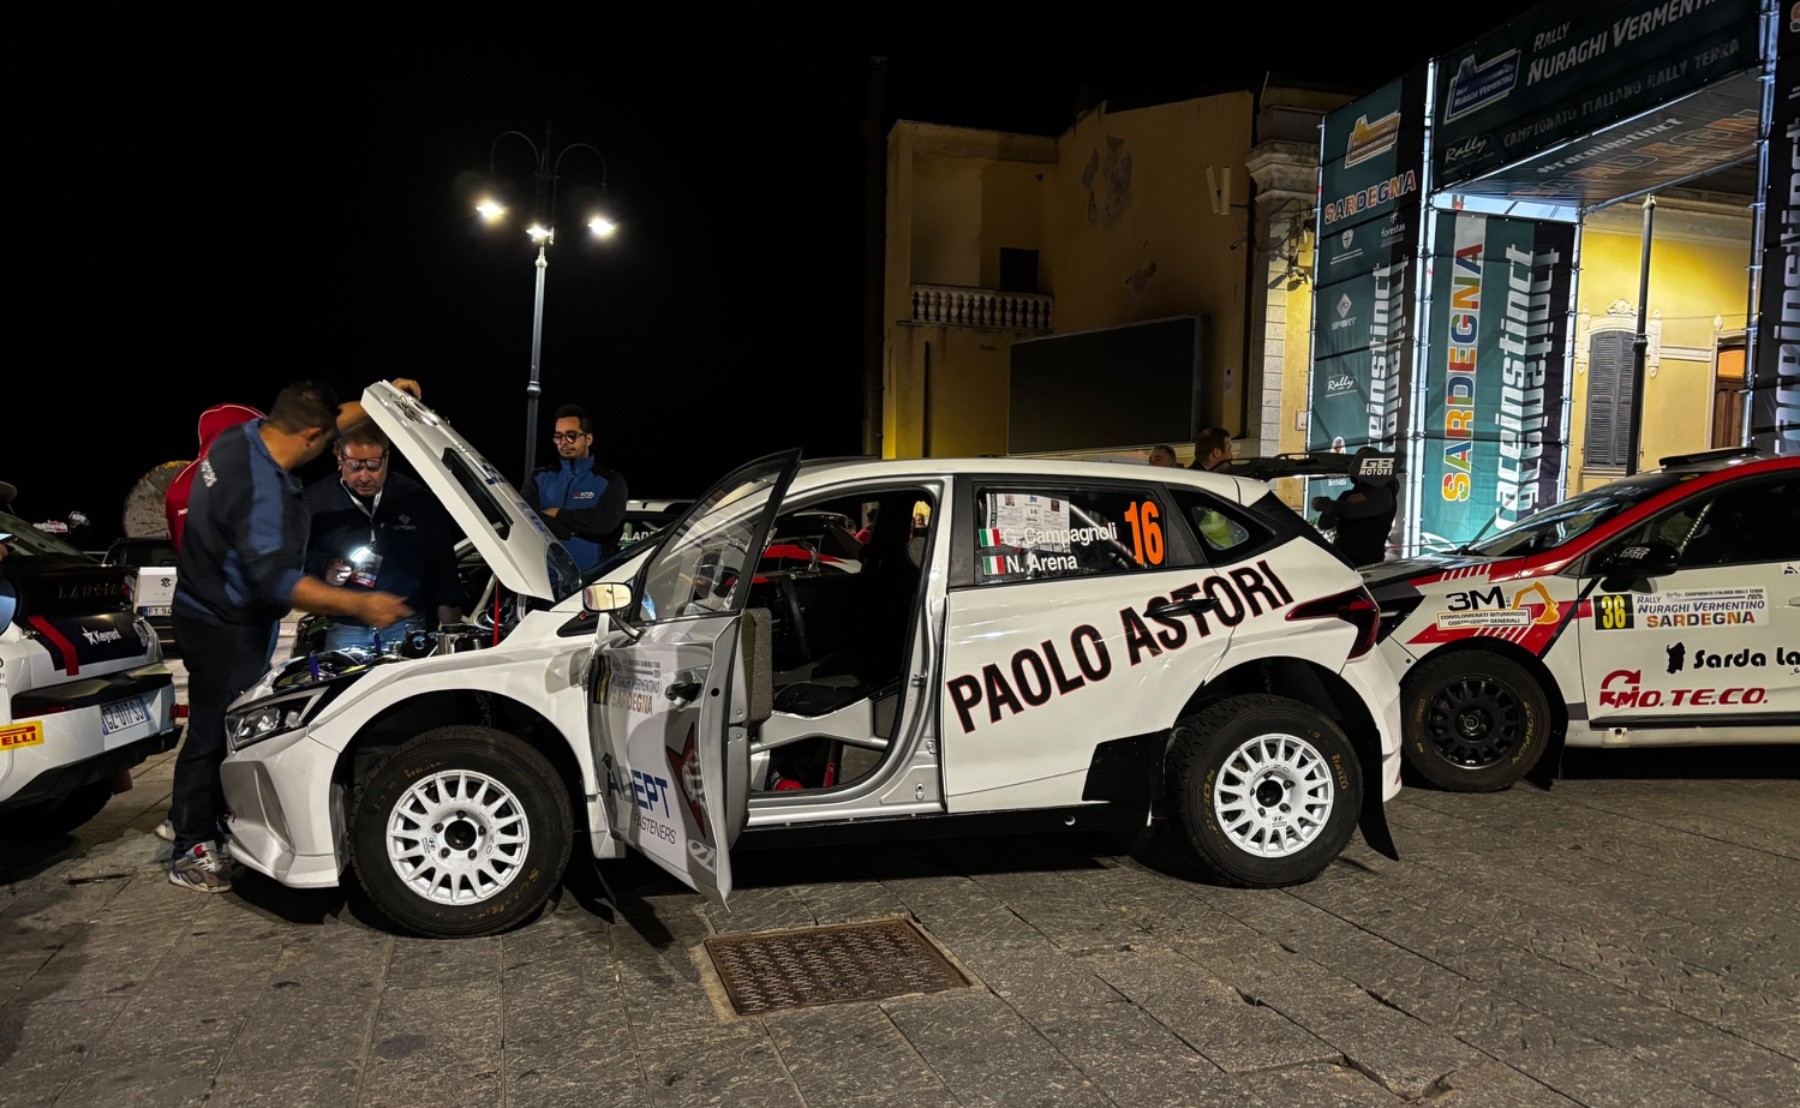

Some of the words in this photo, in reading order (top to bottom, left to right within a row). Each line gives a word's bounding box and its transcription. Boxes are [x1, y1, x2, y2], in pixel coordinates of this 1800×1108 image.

[1533, 22, 1570, 53] RALLY
[1526, 31, 1608, 87] NURAGHI
[1504, 108, 1577, 148] CAMPIONATO
[1581, 80, 1642, 117] ITALIANO
[1647, 59, 1688, 90] RALLY
[1692, 37, 1740, 70] TERRA
[1445, 135, 1488, 164] Rally
[1324, 169, 1417, 226] SARDEGNA
[1328, 376, 1354, 391] Rally
[1442, 243, 1483, 502] SARDEGNA
[1359, 468, 1393, 476] MOTORS
[1360, 458, 1395, 468] GB
[1003, 529, 1022, 546] G.
[1024, 521, 1118, 548] Campagnoli
[1124, 500, 1165, 566] 16
[1006, 558, 1025, 574] N.
[1029, 554, 1078, 571] Arena
[1119, 559, 1294, 667] ASTORI
[1446, 586, 1506, 612] 3M
[1601, 594, 1627, 628] 36
[1637, 596, 1661, 604] RALLY
[1638, 603, 1690, 614] NURAGHI
[1693, 600, 1765, 612] VERMENTINO
[1440, 612, 1489, 620] CONGLOMERATI
[1490, 610, 1527, 618] BITUMINOSI
[1646, 611, 1755, 628] SARDEGNA
[1693, 648, 1767, 669] Sarda
[946, 624, 1113, 735] PAOLO
[633, 813, 678, 845] FASTENERS
